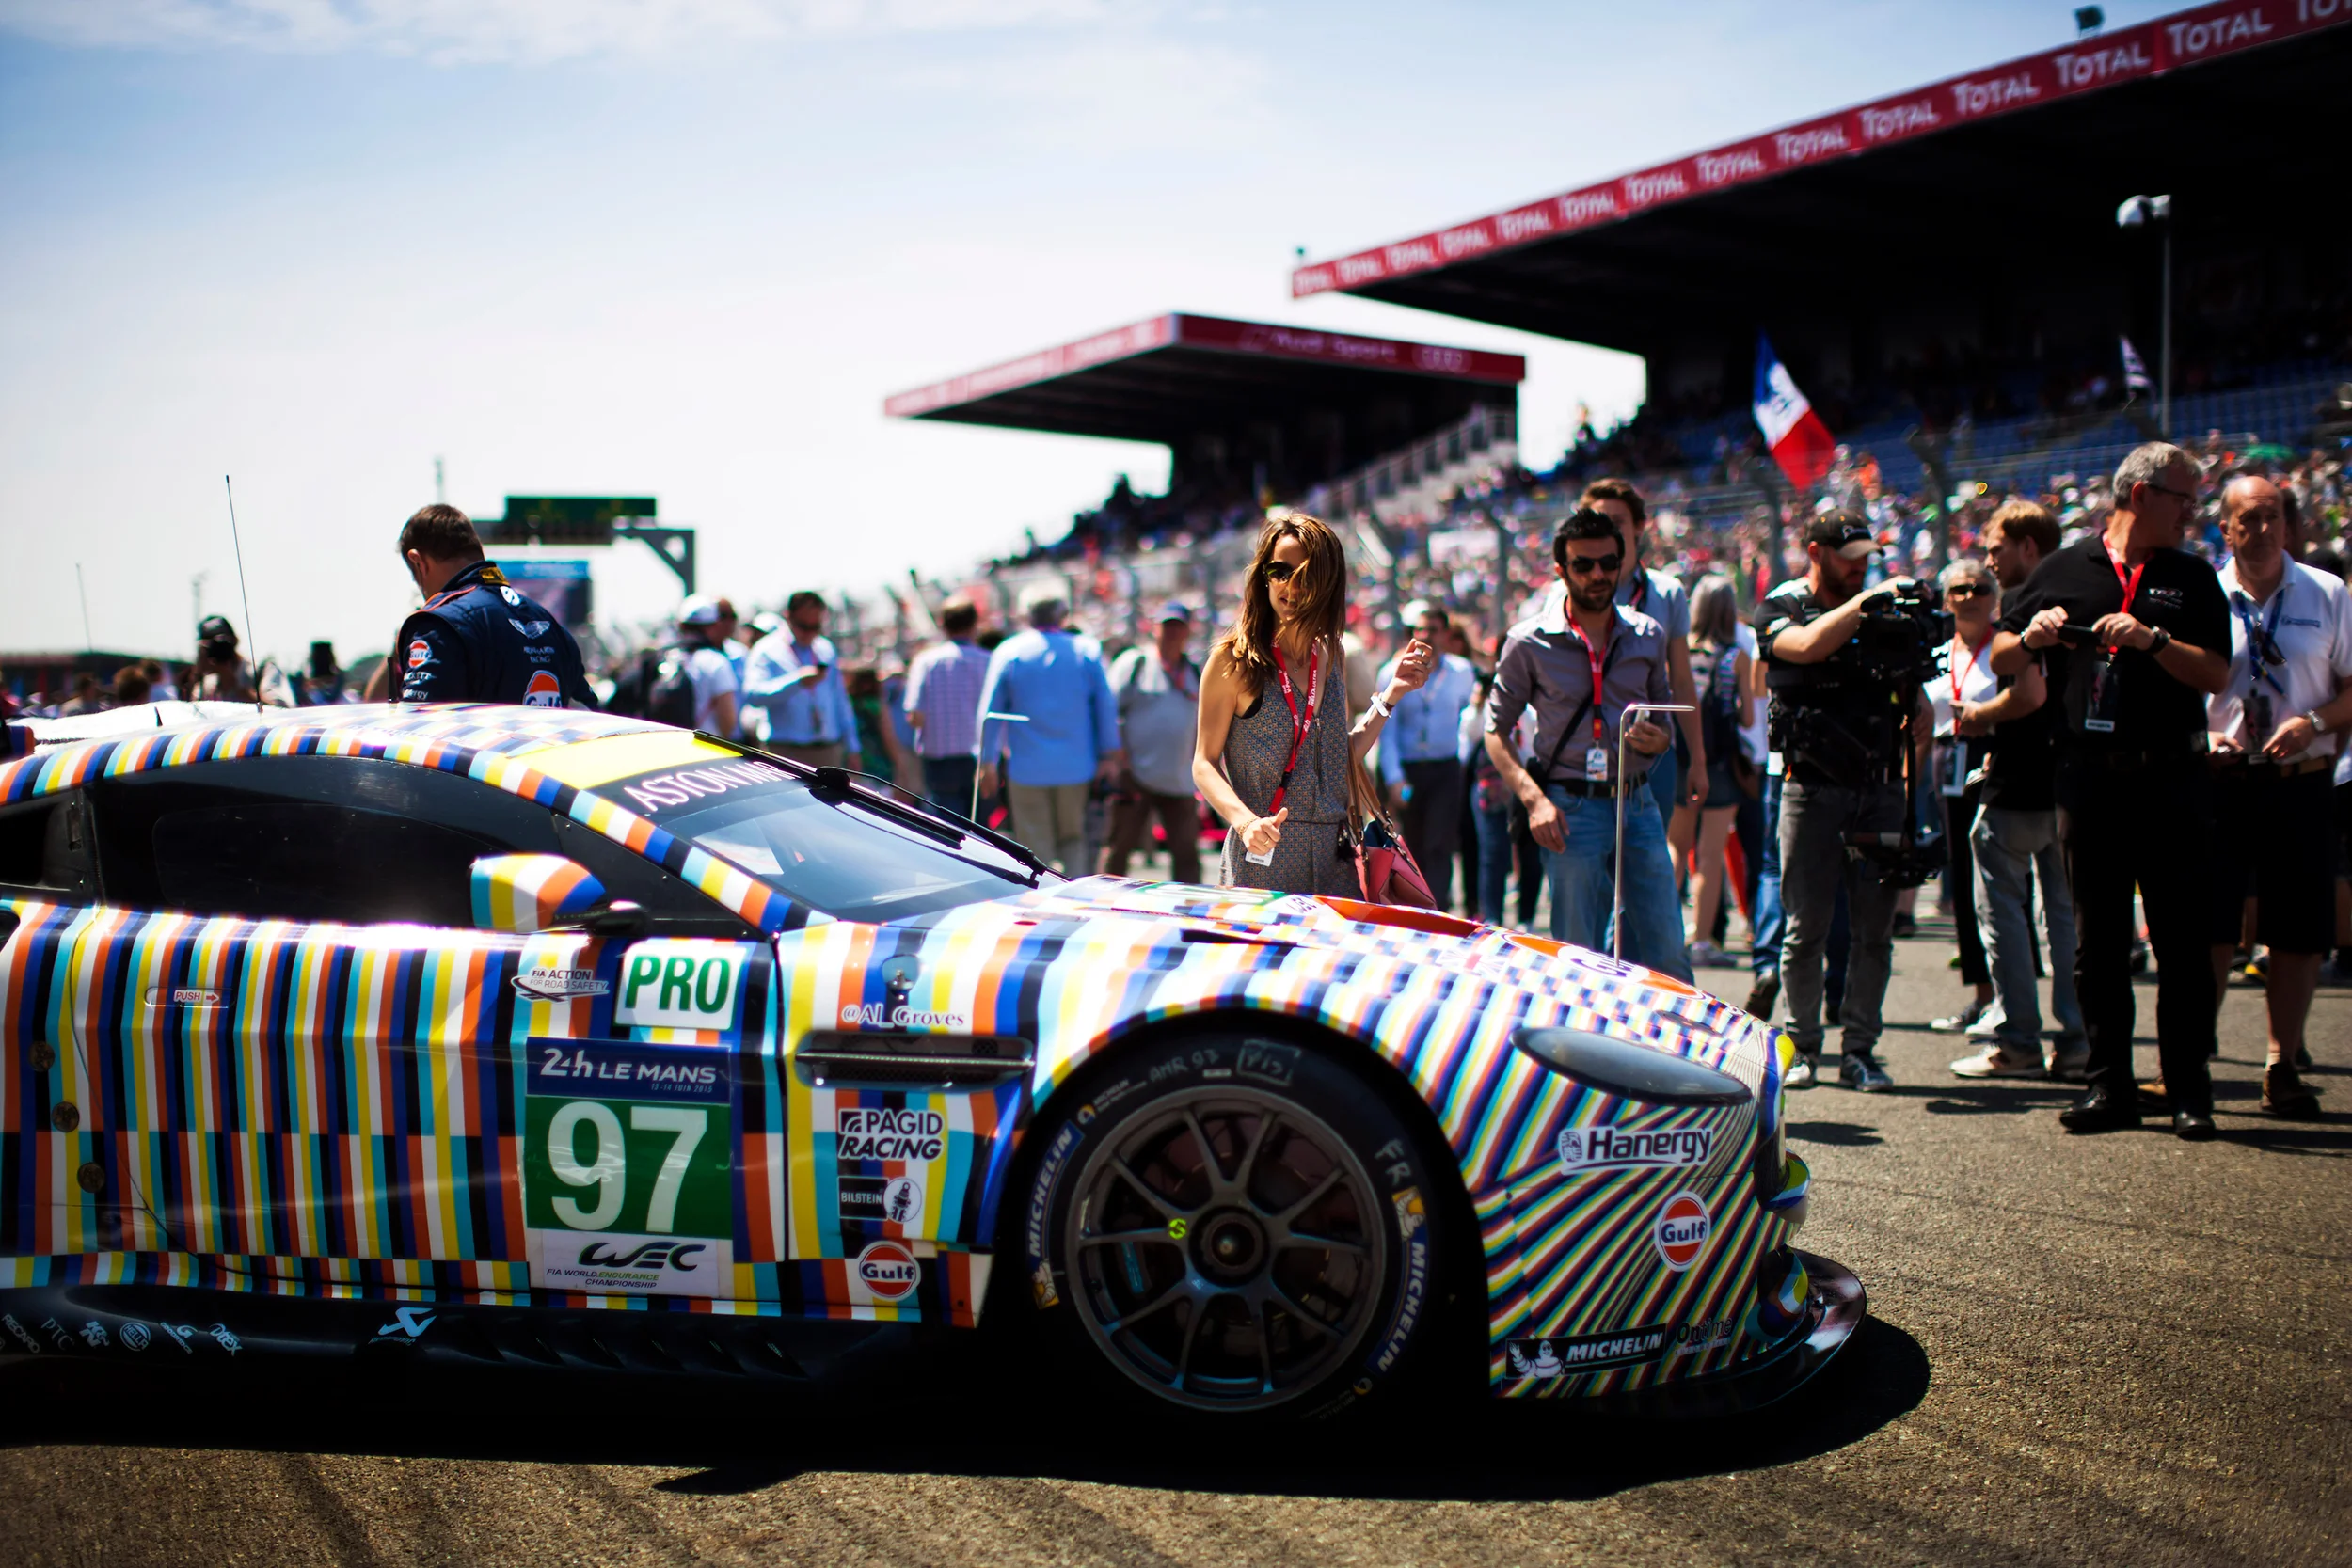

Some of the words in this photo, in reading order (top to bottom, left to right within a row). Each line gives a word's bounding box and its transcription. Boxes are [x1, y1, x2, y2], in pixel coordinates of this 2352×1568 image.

[2168, 8, 2273, 56] TOTAL
[2056, 46, 2150, 86] TOTAL
[1952, 73, 2040, 114] TOTAL
[1859, 101, 1940, 138] TOTAL
[1773, 128, 1850, 160] TOTAL
[624, 767, 752, 812] ASTON
[545, 980, 569, 989] ROAD
[571, 981, 607, 990] SAFETY
[548, 970, 591, 980] ACTION
[625, 956, 730, 1014] PRO
[176, 991, 200, 1000] PUSH
[598, 1062, 632, 1080] LE
[637, 1064, 716, 1084] MANS
[866, 1111, 943, 1135] PAGID
[840, 1137, 943, 1160] RACING
[1588, 1130, 1710, 1164] Hanergy
[548, 1101, 707, 1233] 97
[841, 1192, 882, 1205] BILSTEIN
[1029, 1128, 1072, 1257] MICHELIN
[1661, 1221, 1705, 1243] Gulf
[578, 1242, 706, 1272] WEC
[861, 1262, 914, 1280] Gulf
[585, 1278, 657, 1289] CHAMPIONSHIP
[598, 1272, 660, 1281] ENDURANCE
[1377, 1242, 1425, 1372] MICHELIN
[4, 1314, 40, 1354] RECARO
[123, 1324, 149, 1351] HELLA
[1566, 1332, 1663, 1363] MICHELIN
